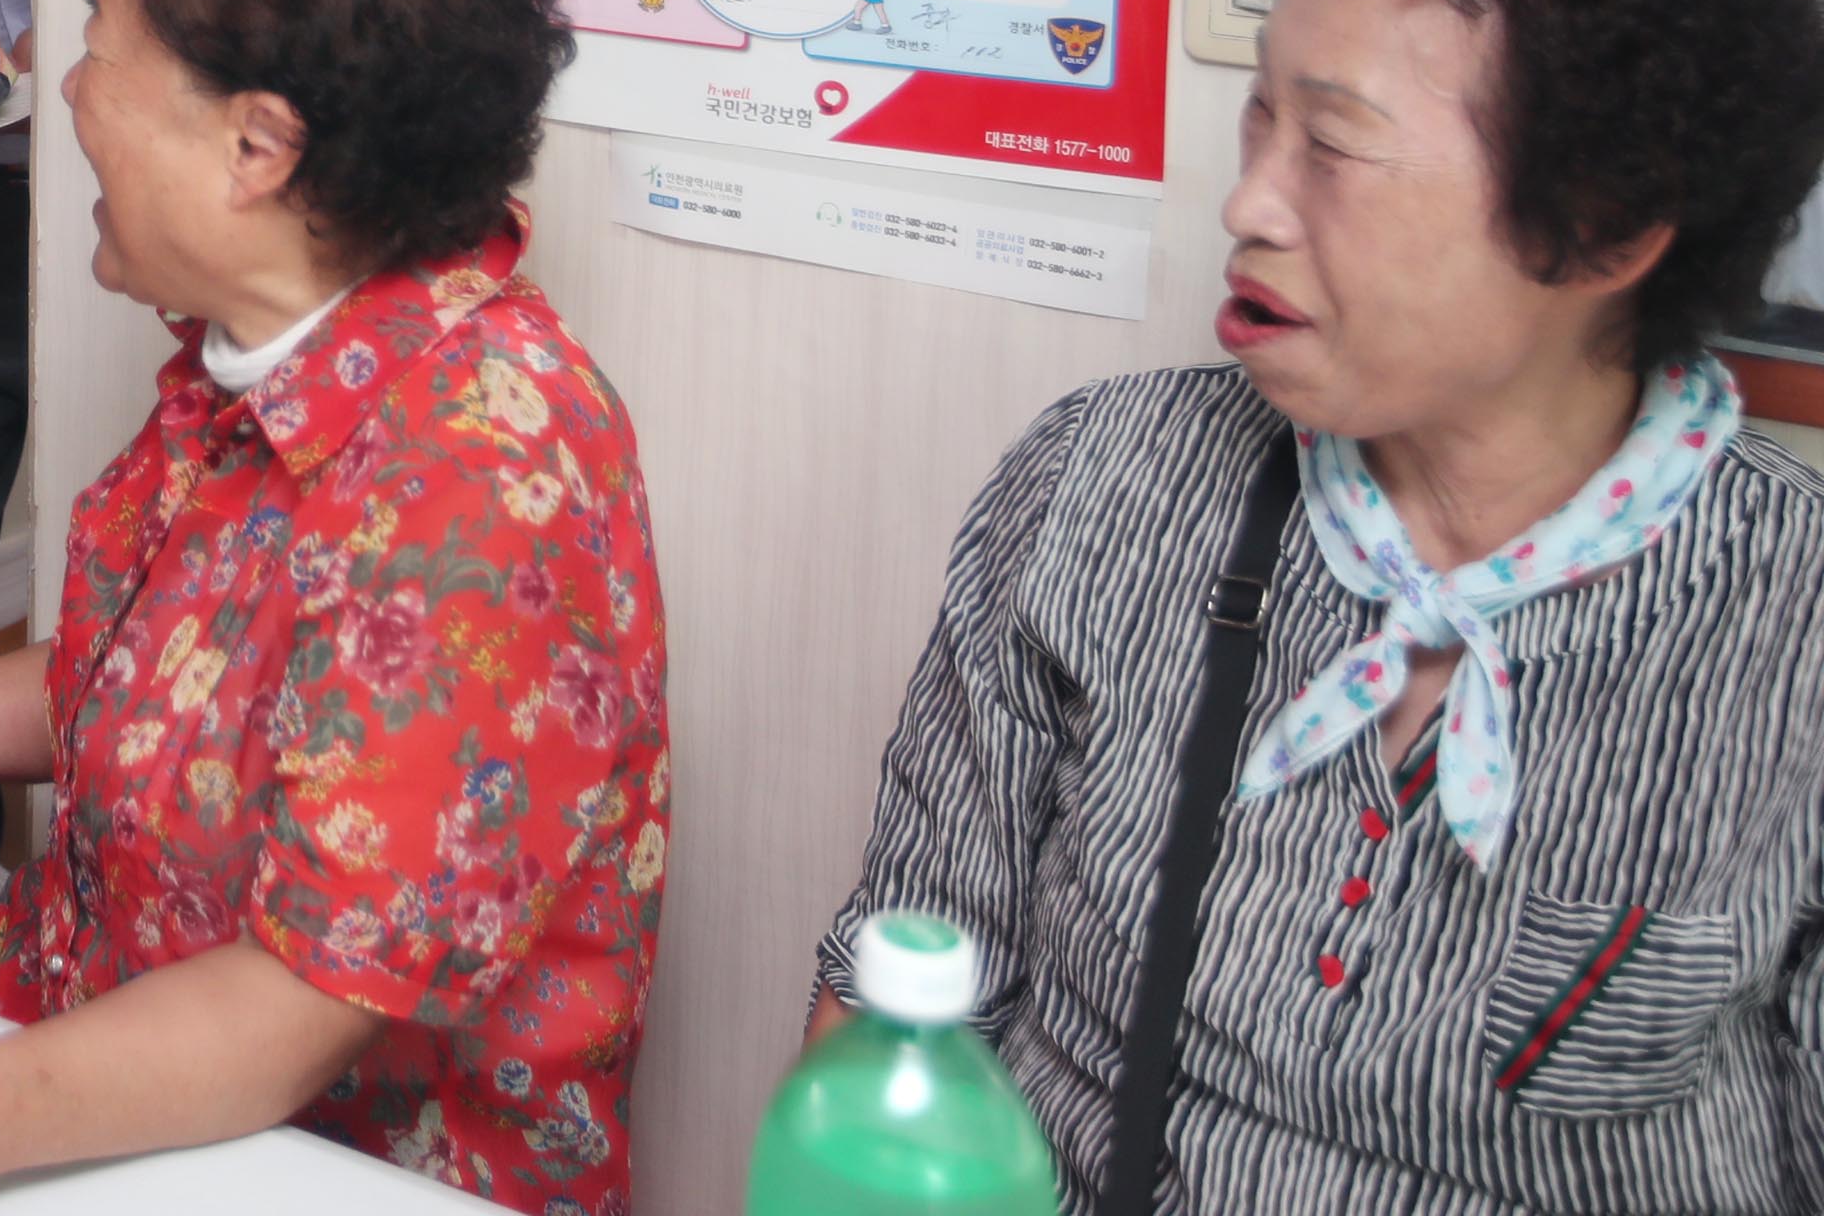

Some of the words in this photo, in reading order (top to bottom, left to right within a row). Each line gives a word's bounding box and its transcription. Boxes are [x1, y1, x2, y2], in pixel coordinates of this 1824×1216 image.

[705, 97, 812, 128] 국민건강보험
[985, 131, 1049, 154] 대표전화
[1054, 140, 1130, 163] 1577-1000
